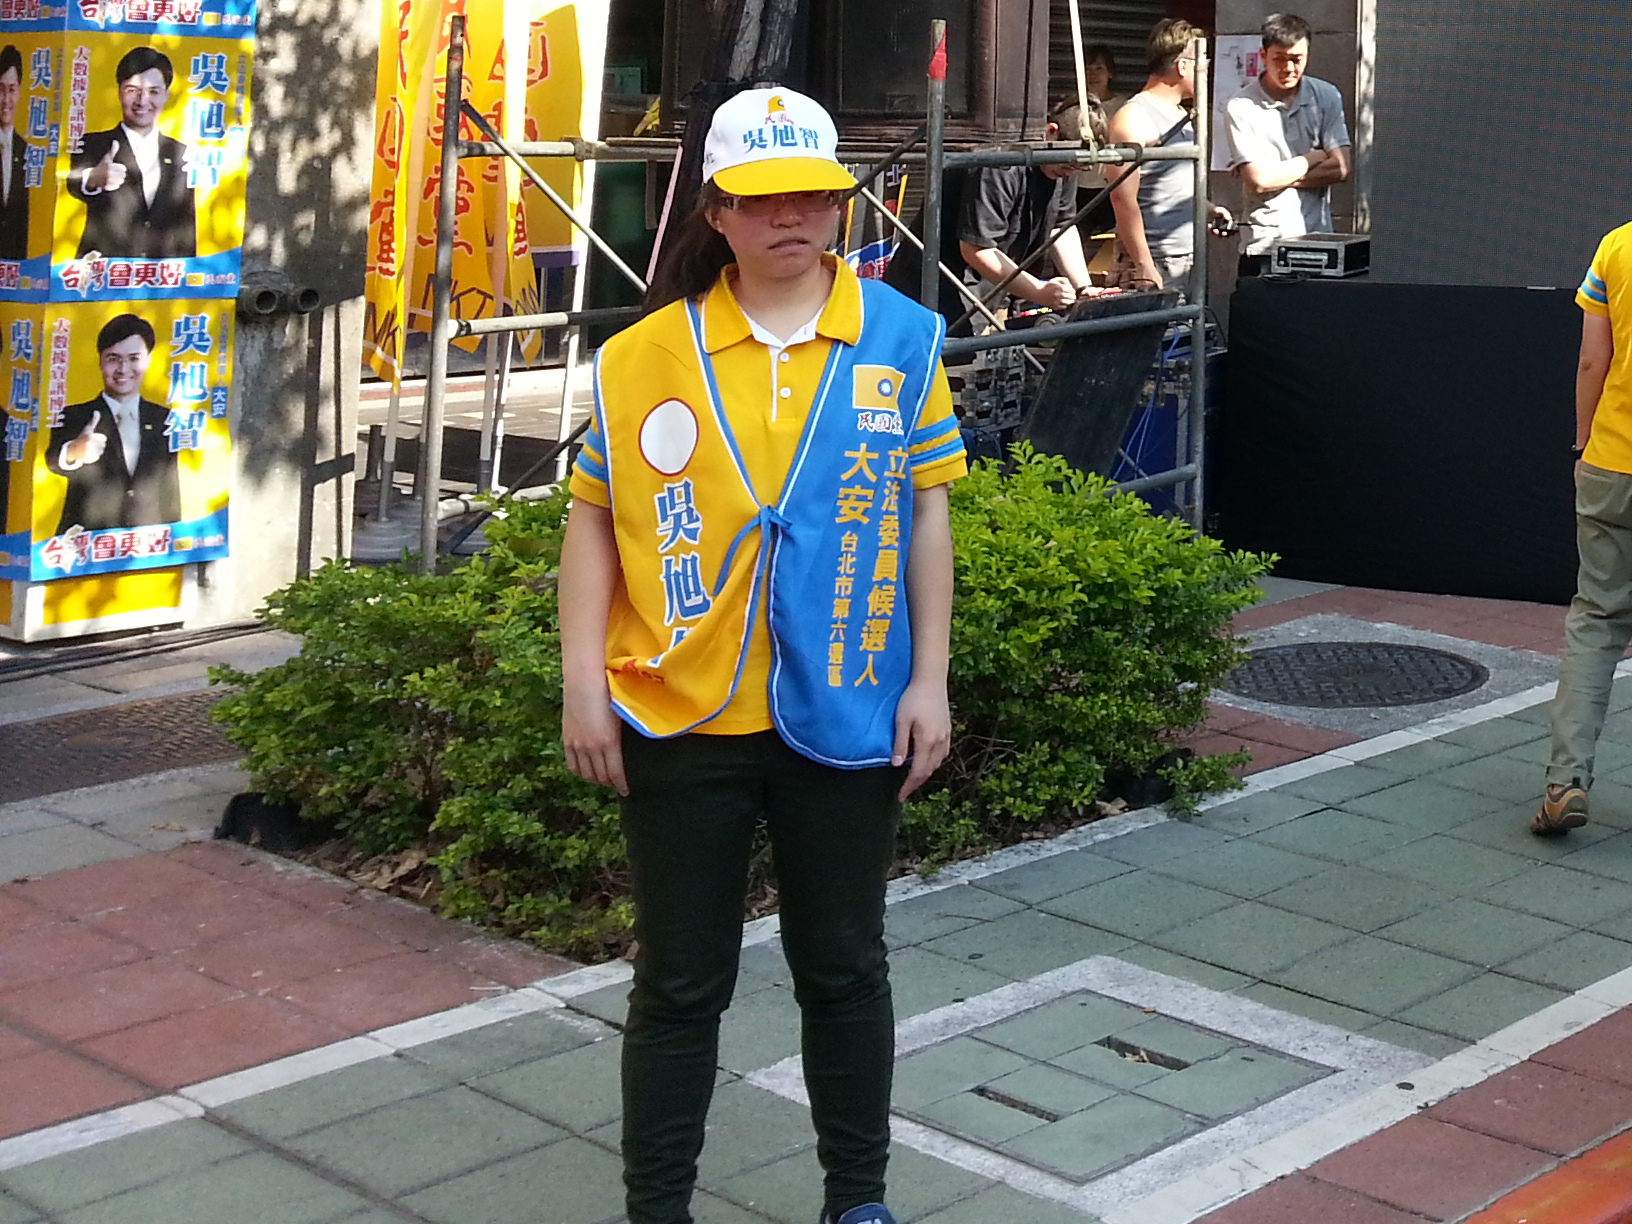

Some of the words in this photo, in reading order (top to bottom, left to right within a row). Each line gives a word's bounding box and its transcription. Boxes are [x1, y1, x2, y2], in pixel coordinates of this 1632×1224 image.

[742, 123, 820, 153] 吳旭智
[163, 312, 214, 453] 吳旭智
[834, 442, 880, 525] 大安
[654, 477, 713, 652] 吳旭
[828, 530, 859, 688] 台北市第六選區
[853, 446, 909, 688] 立法委員候選人
